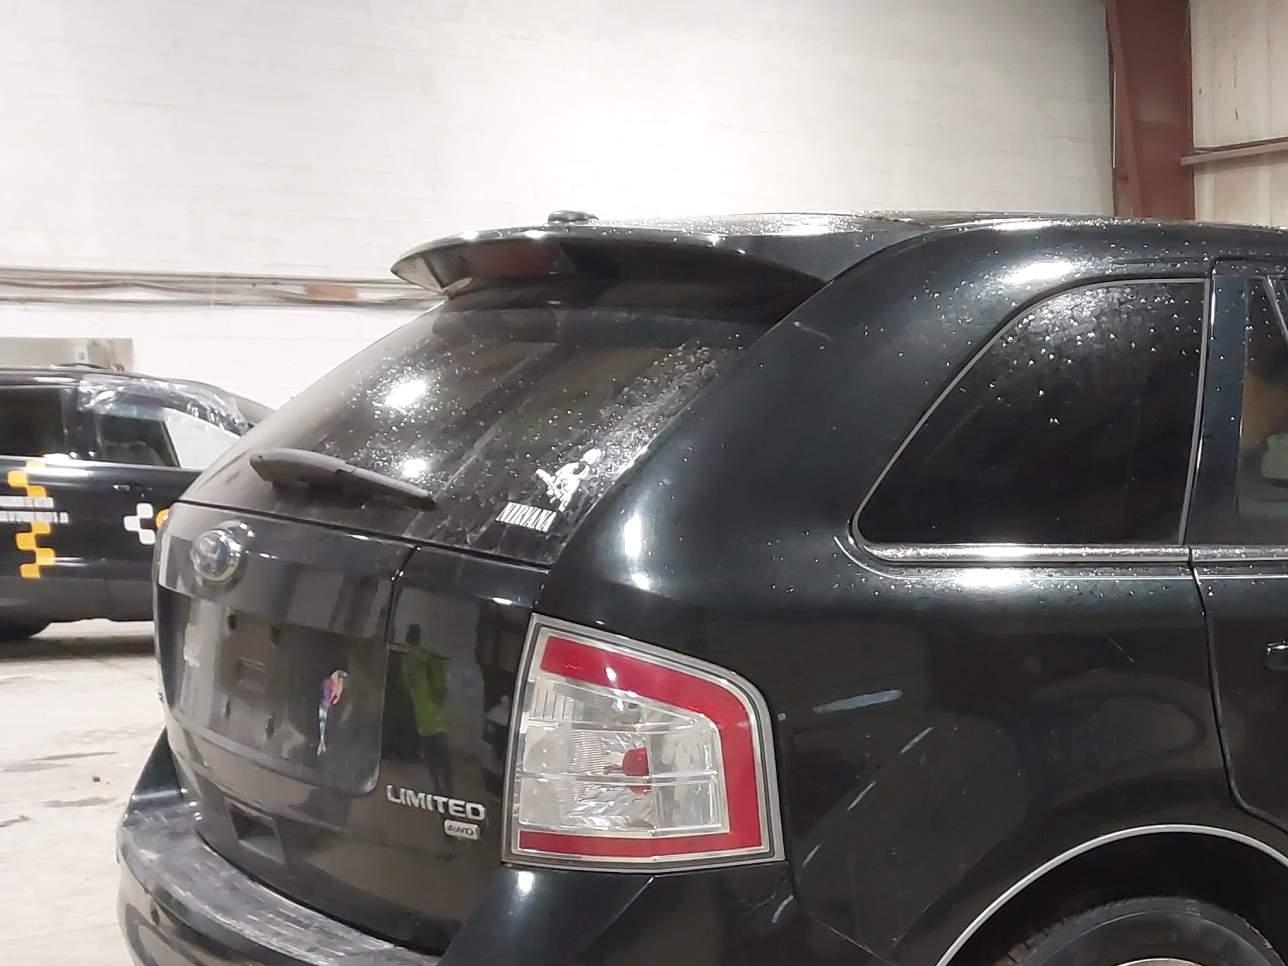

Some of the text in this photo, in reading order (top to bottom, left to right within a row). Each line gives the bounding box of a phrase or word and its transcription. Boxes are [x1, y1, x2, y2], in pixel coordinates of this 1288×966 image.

[495, 501, 557, 533] NIRVANA
[386, 784, 486, 821] LIMITED
[447, 823, 475, 837] AWD
